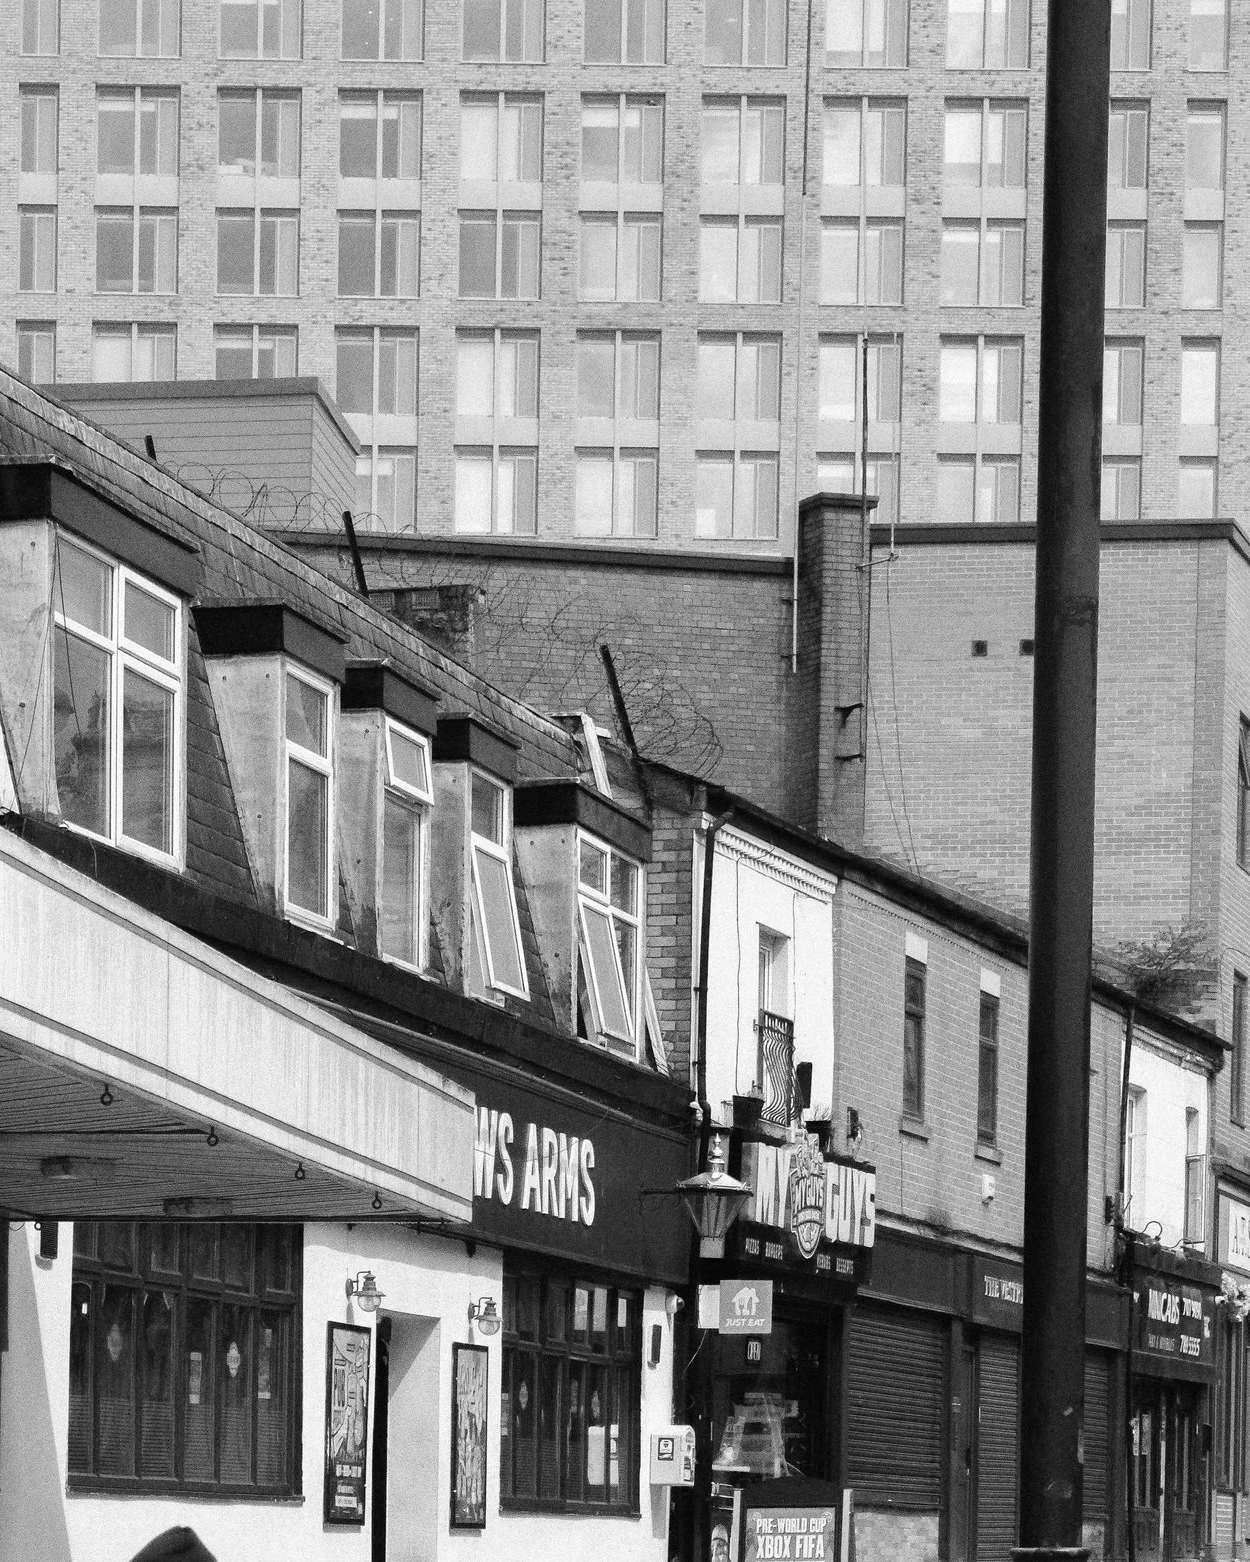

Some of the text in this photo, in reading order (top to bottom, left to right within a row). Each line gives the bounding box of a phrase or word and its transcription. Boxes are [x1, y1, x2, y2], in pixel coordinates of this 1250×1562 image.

[521, 1122, 595, 1227] ARMS
[755, 1142, 876, 1248] MY GUYS
[725, 1318, 765, 1327] JUST EAT
[756, 1518, 826, 1534] PRE-WORLD CUP
[756, 1534, 825, 1559] XBOX FIFA
